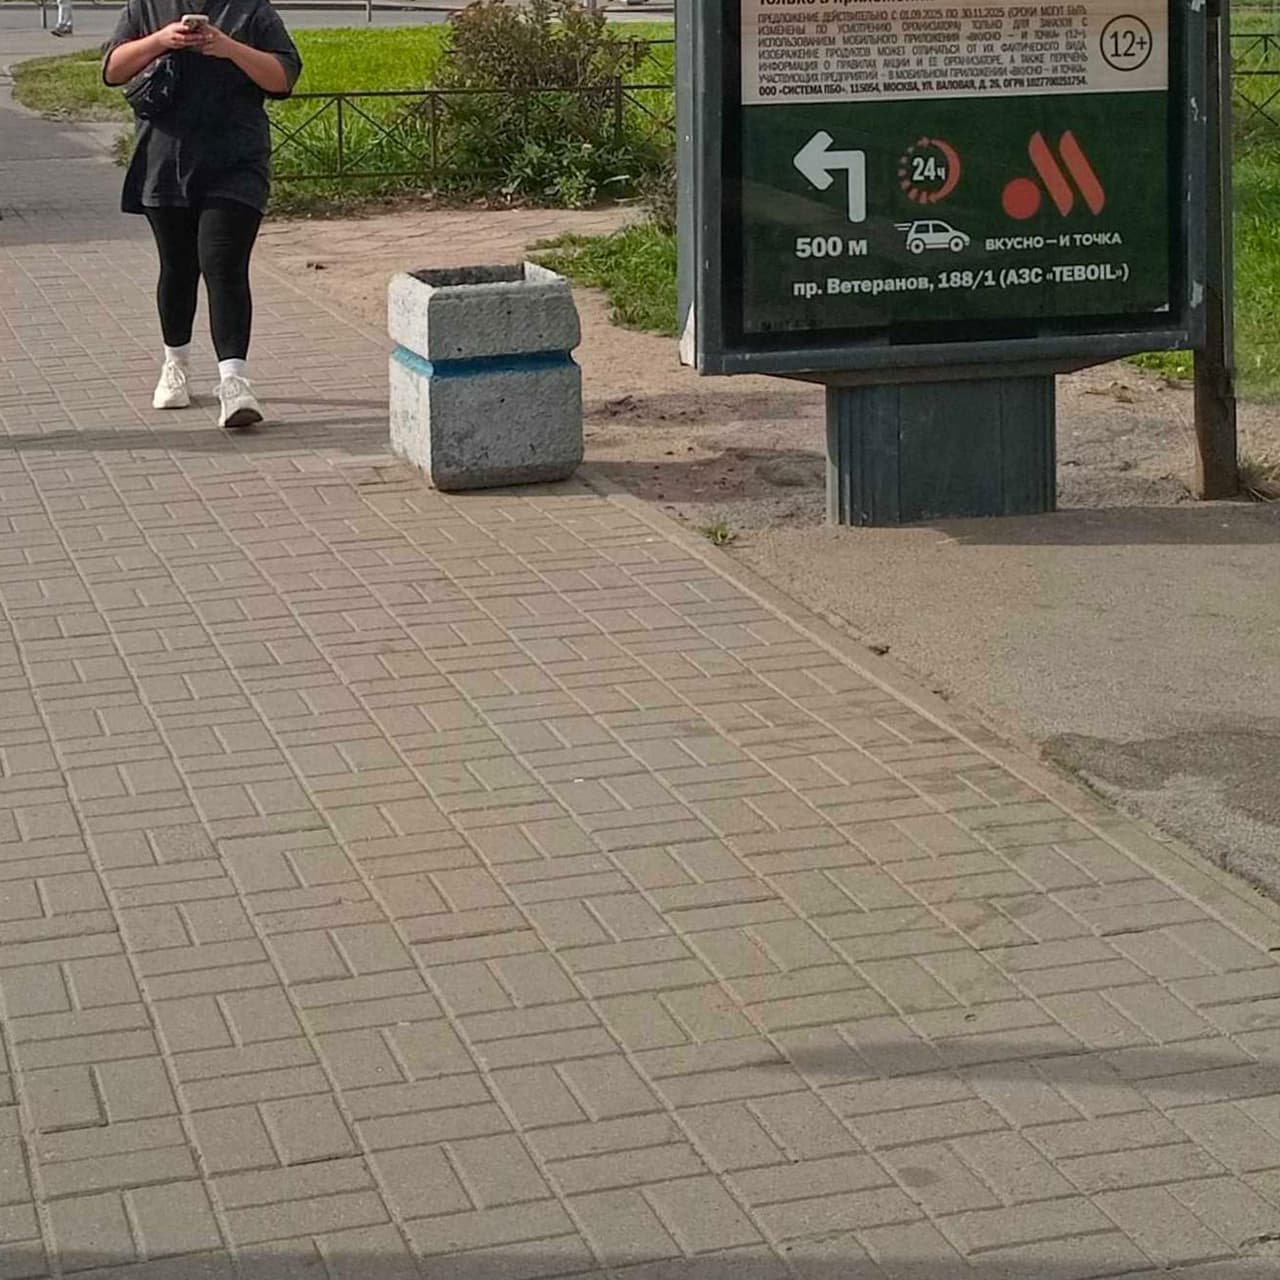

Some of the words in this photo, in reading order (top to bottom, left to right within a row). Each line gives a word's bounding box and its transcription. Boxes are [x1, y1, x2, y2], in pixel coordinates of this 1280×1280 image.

[1110, 30, 1148, 57] 12+
[759, 86, 777, 96] ООО
[912, 157, 946, 182] 24ч
[795, 236, 842, 258] 500
[848, 239, 868, 256] м
[985, 236, 1044, 251] ВКУСНО
[1073, 232, 1122, 246] ТОЧКА
[793, 282, 822, 299] пр.
[827, 276, 934, 295] Ветеранов,
[937, 270, 996, 290] 188/1
[999, 267, 1043, 288] (АЗС
